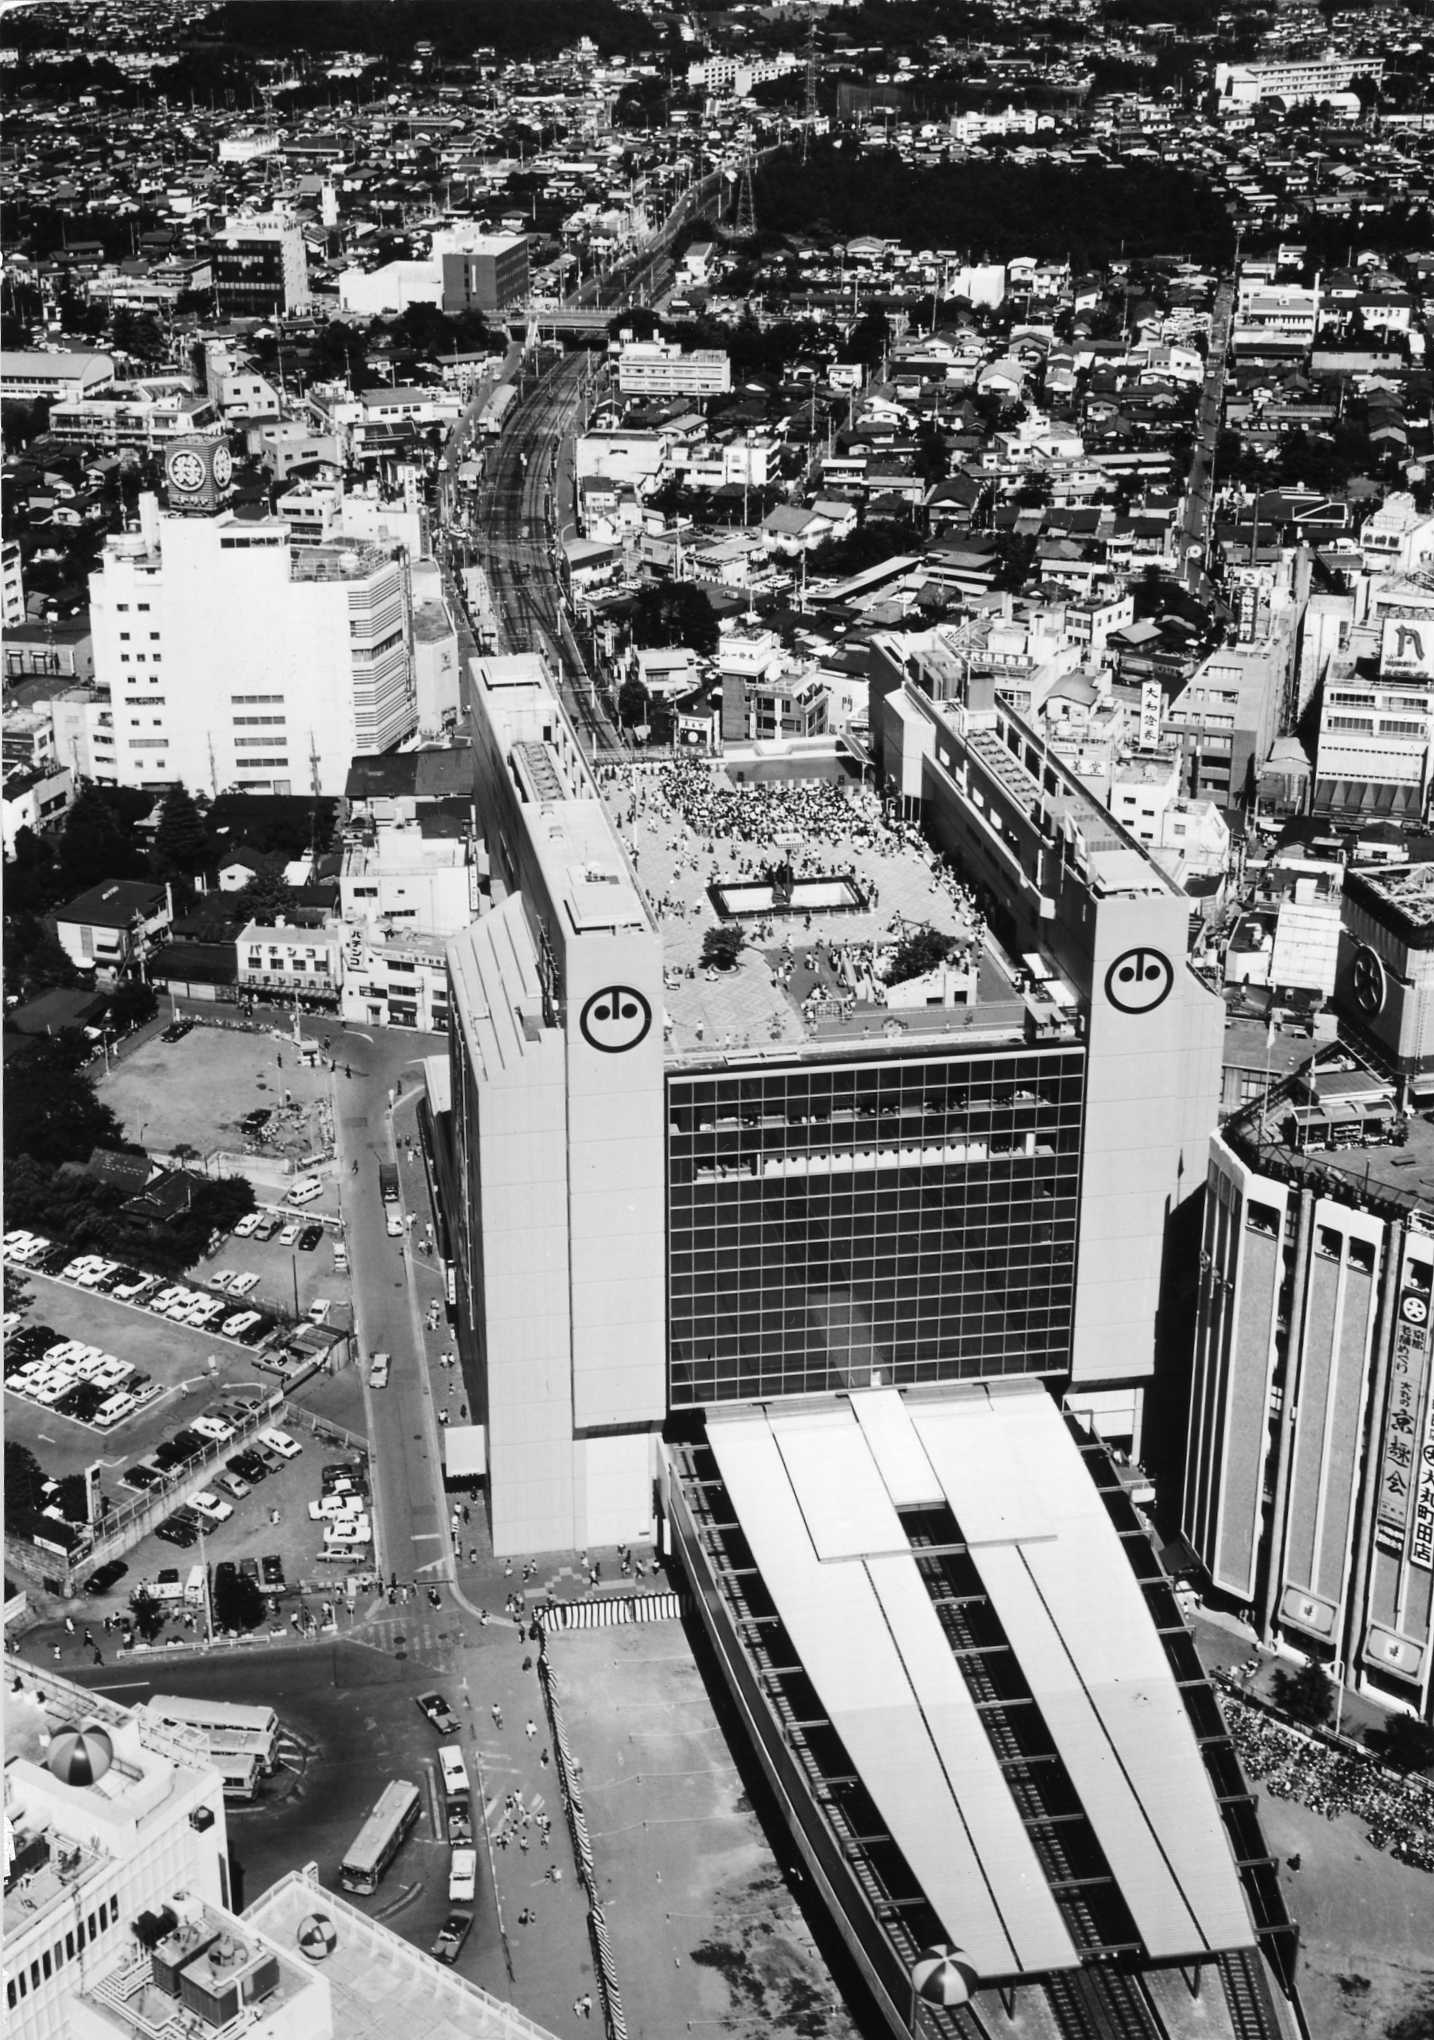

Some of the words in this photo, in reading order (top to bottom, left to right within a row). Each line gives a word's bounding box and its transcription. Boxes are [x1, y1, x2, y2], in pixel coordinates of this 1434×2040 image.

[250, 944, 316, 958] パチンコ
[350, 930, 361, 966] パチンコ
[1413, 1469, 1434, 1563] 大丸町田店
